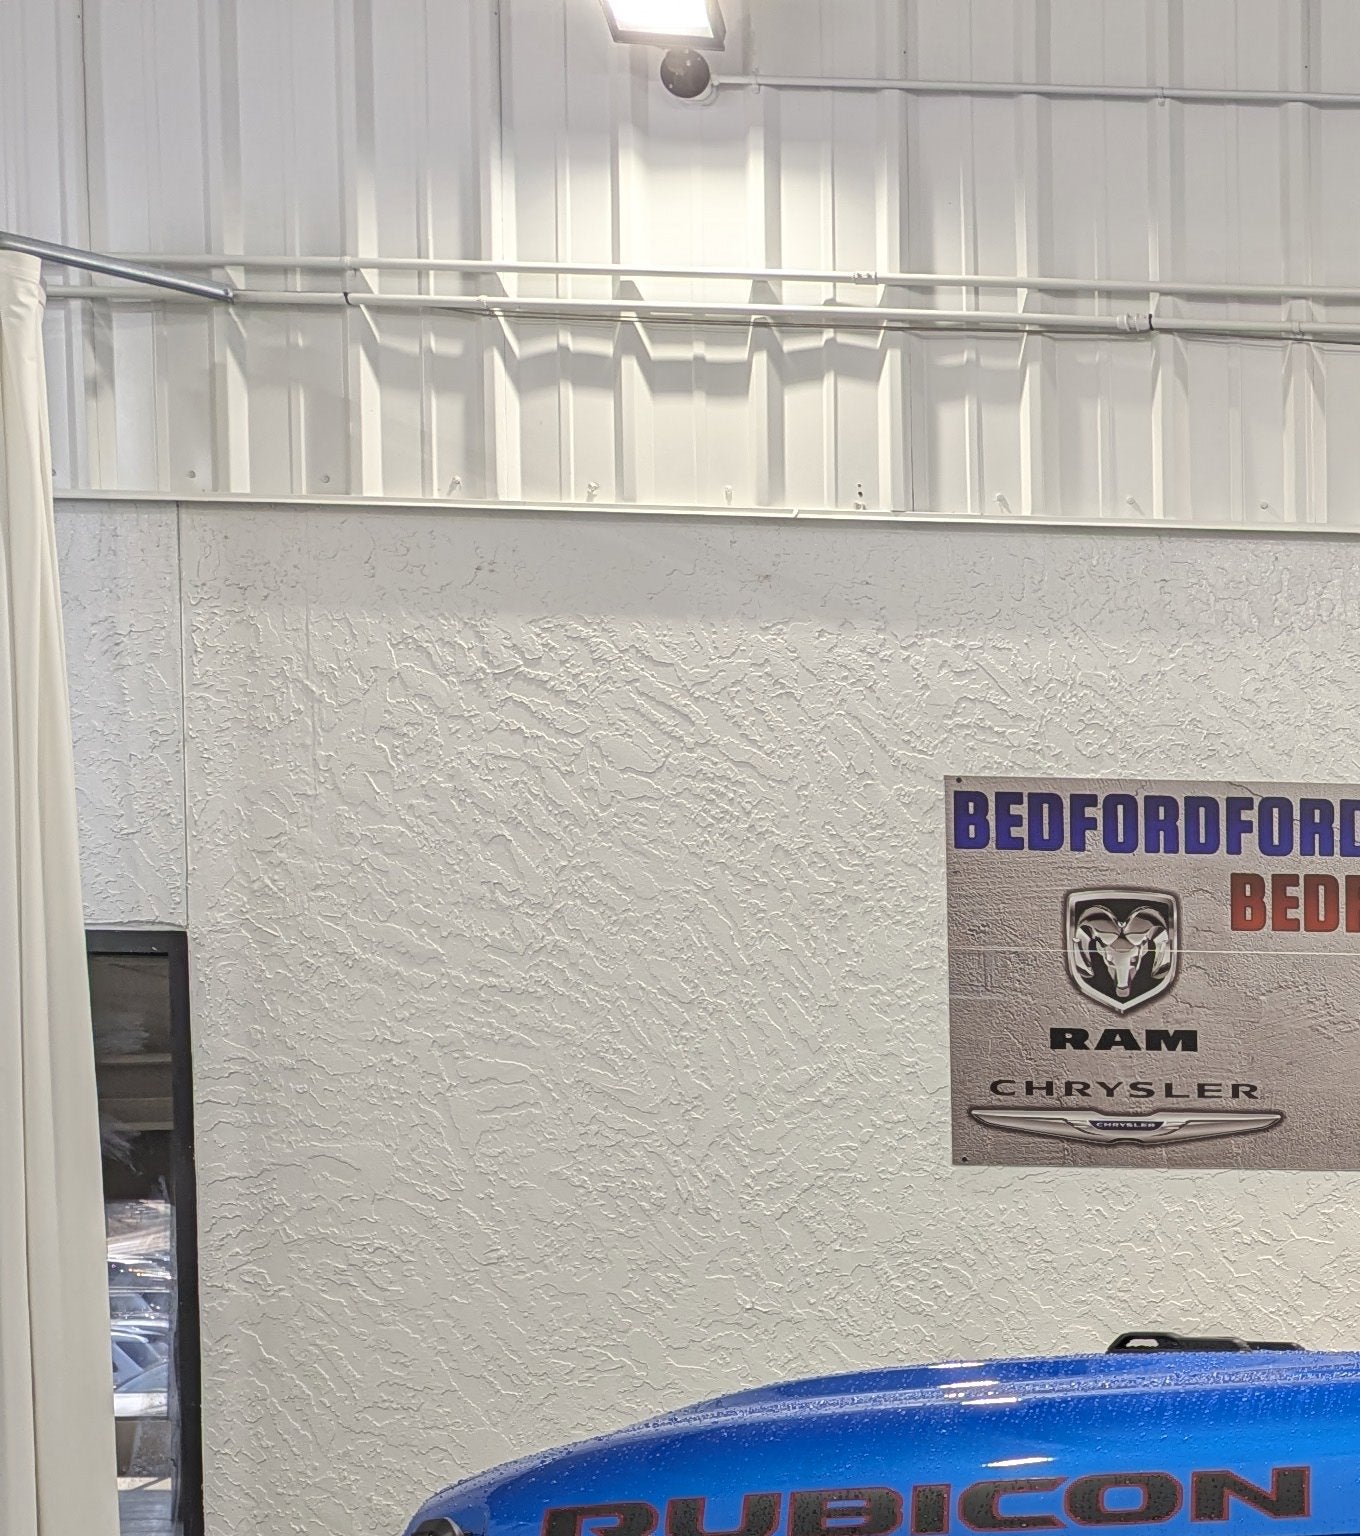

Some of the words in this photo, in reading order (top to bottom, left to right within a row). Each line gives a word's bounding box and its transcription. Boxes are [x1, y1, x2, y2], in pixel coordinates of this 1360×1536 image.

[1049, 1026, 1199, 1053] RAM
[989, 1078, 1260, 1101] CHRYSLER
[1095, 1121, 1156, 1129] CHRYSLER
